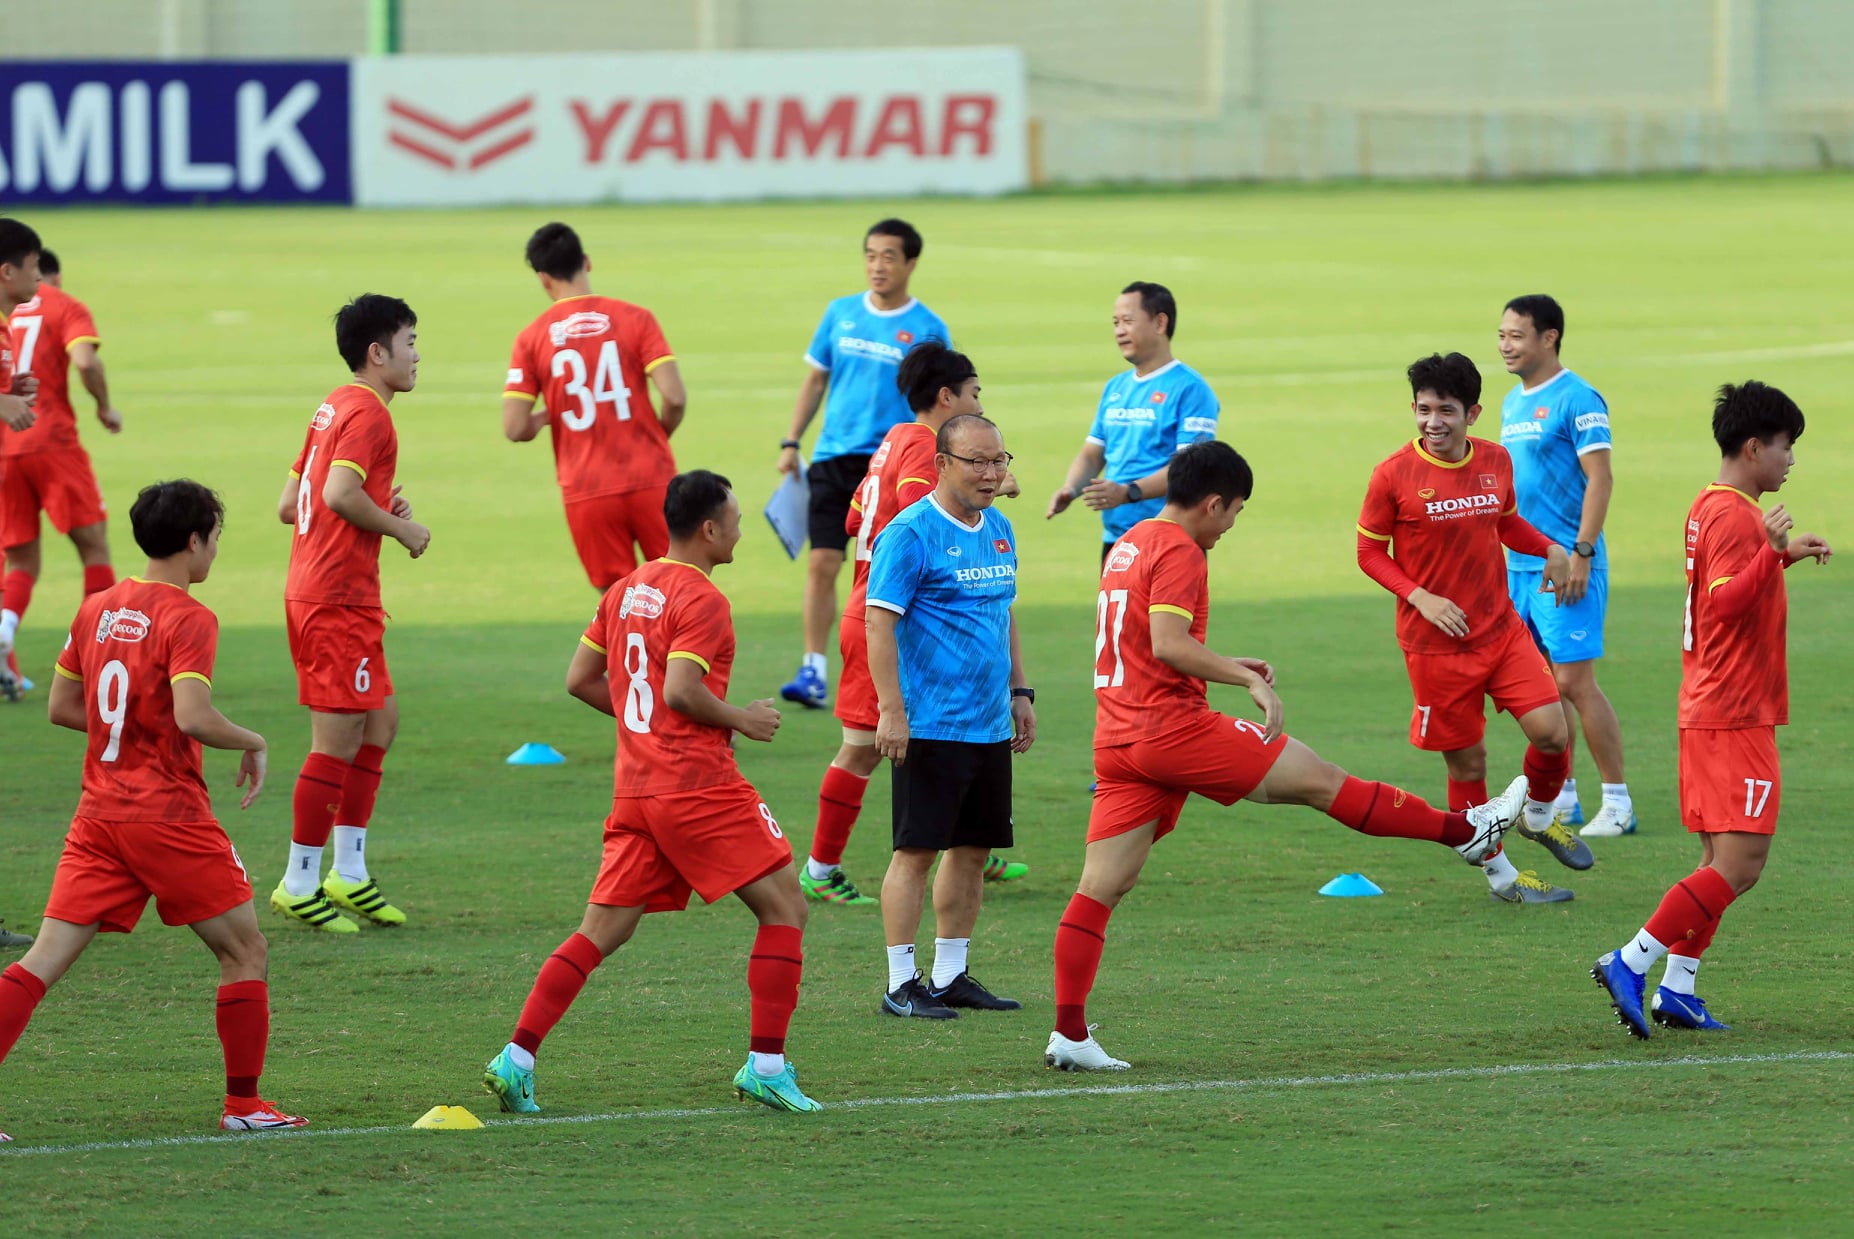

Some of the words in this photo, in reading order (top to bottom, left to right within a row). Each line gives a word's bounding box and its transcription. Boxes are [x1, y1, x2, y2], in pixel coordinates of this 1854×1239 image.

[0, 79, 326, 192] MILK
[568, 95, 999, 165] YANMAR
[839, 337, 904, 360] HONDA
[551, 340, 632, 431] 34
[1105, 407, 1157, 420] HONDA
[298, 445, 318, 535] 6
[1425, 494, 1500, 514] HONDA
[1445, 511, 1466, 519] Power
[955, 565, 1016, 582] HONDA
[973, 581, 990, 589] Power
[1094, 589, 1128, 689] 27
[355, 657, 370, 693] 6
[624, 632, 654, 733] 8
[97, 659, 129, 762] 9
[1234, 719, 1271, 745] 2
[1744, 778, 1773, 818] 17
[758, 802, 783, 838] 8
